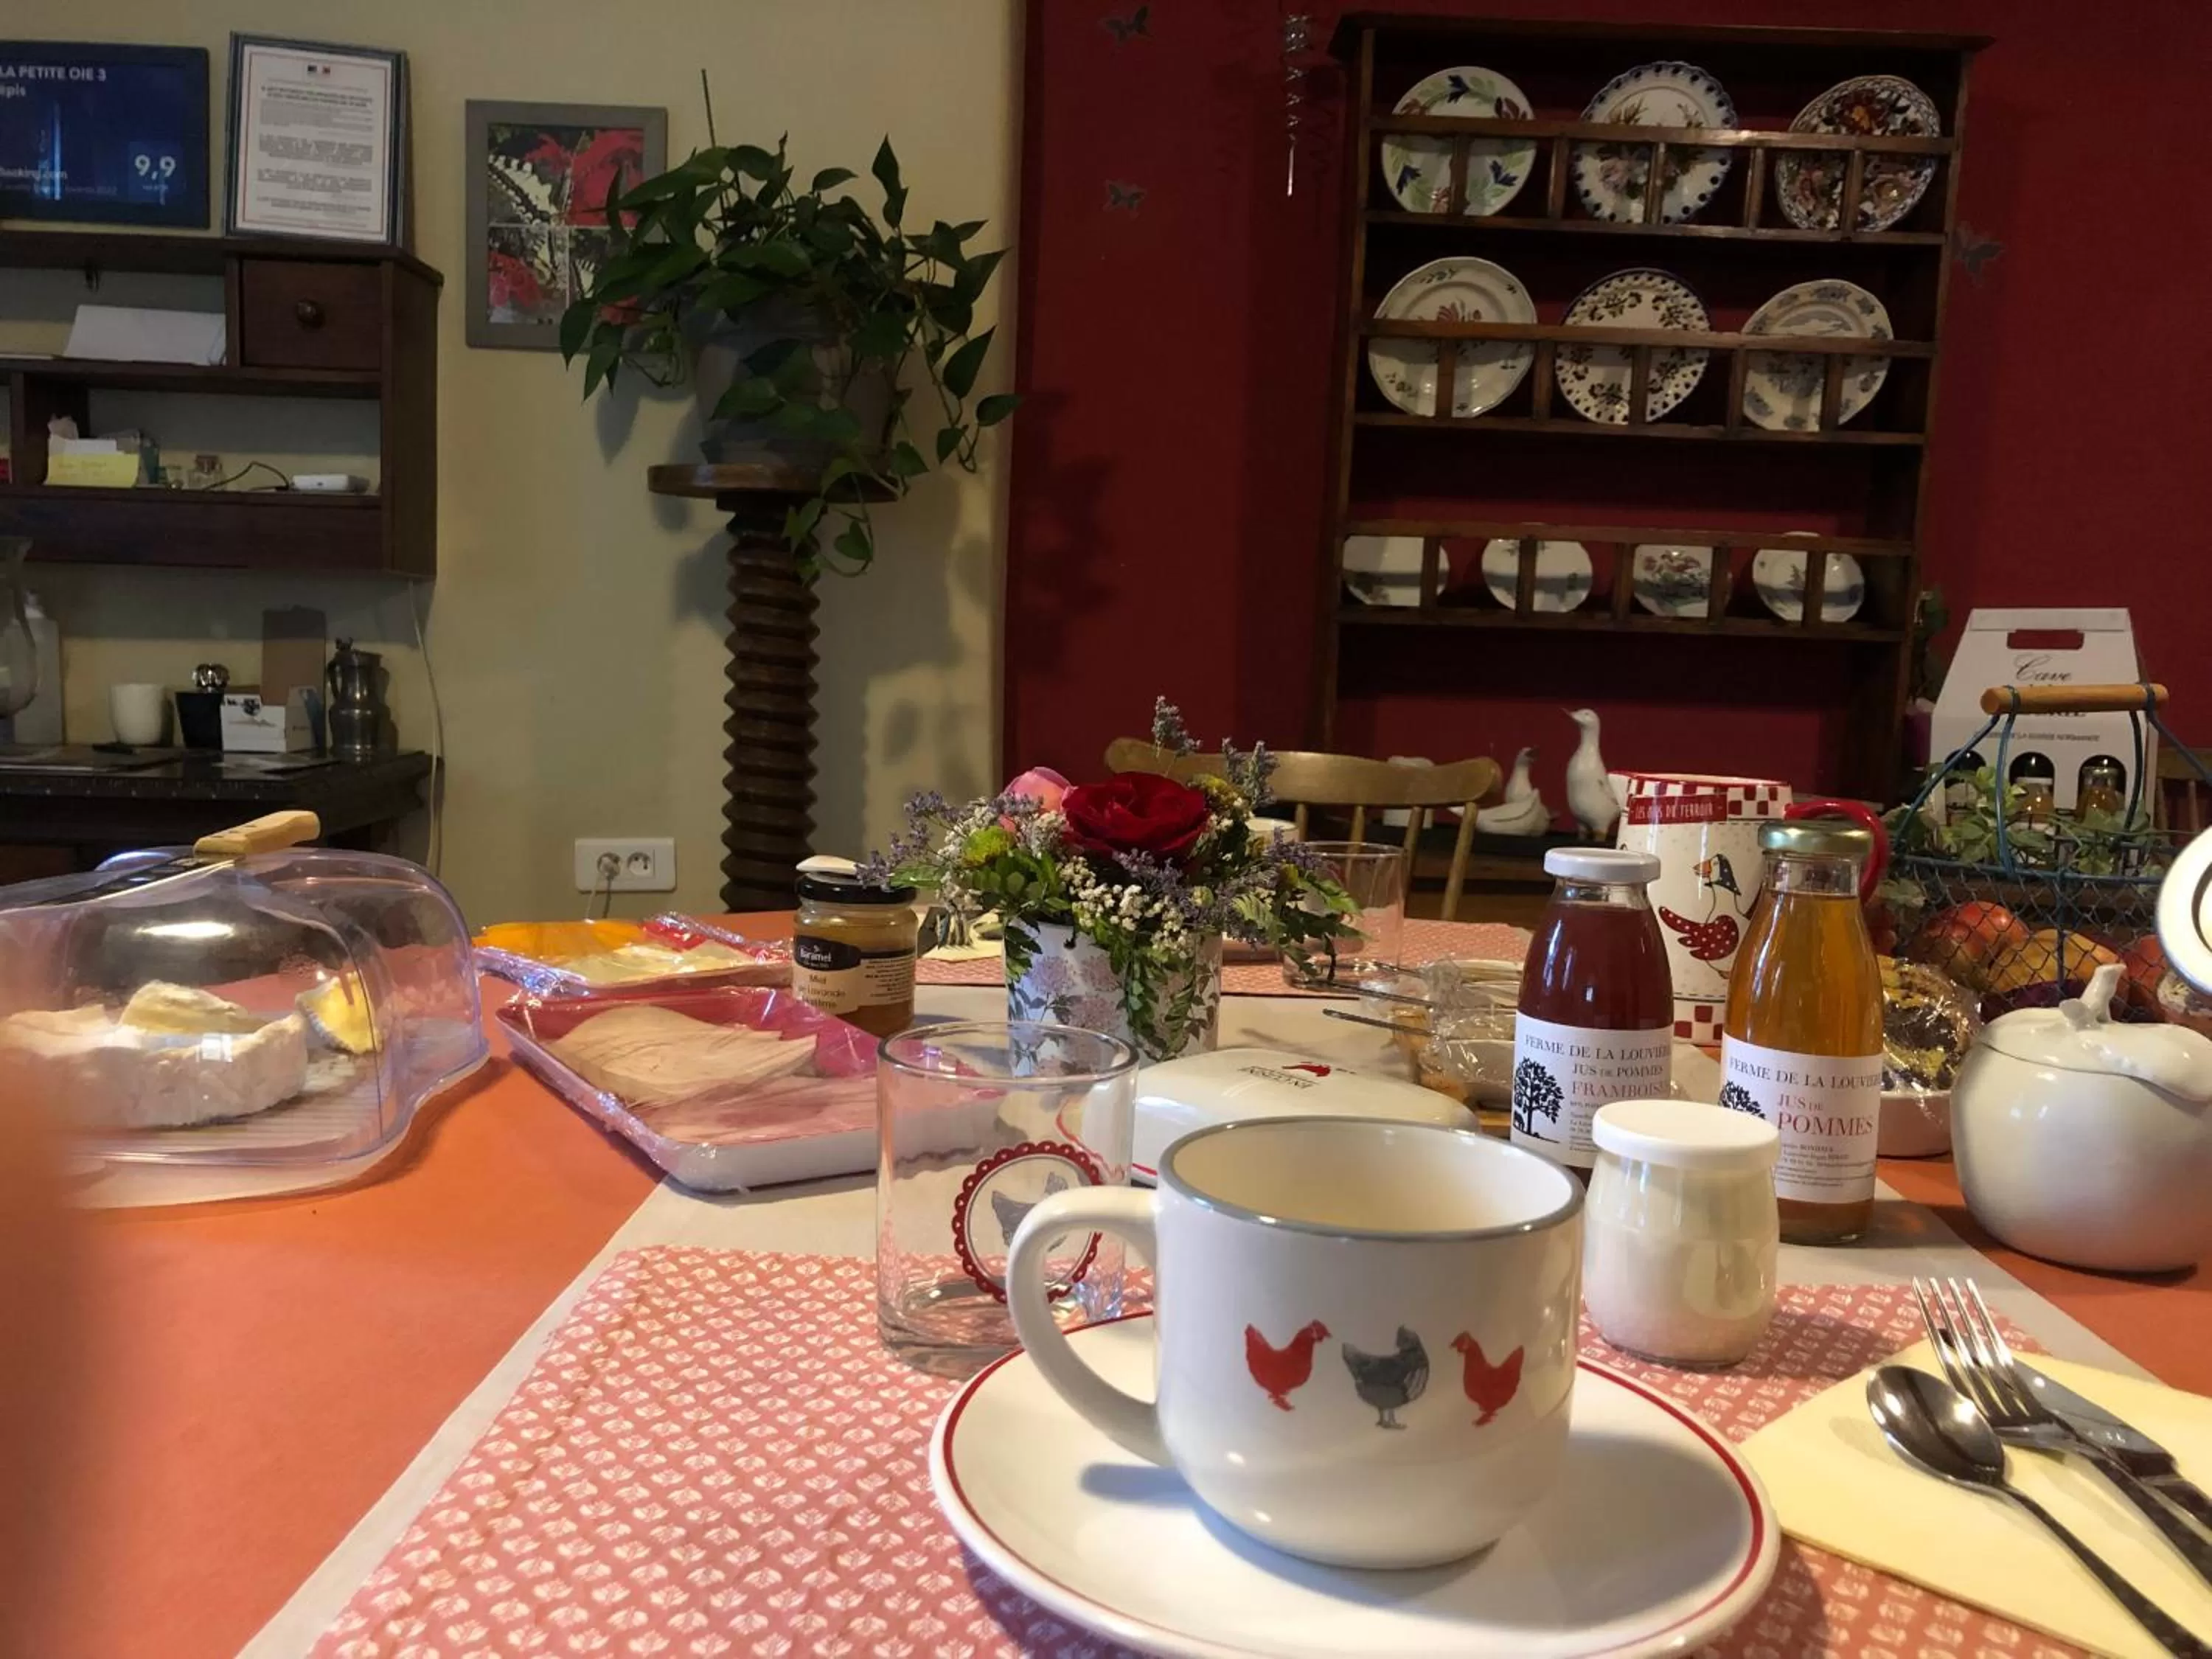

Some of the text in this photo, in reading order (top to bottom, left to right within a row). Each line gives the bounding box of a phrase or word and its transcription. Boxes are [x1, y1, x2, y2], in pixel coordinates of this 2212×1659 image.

[18, 65, 66, 80] PETITE
[69, 66, 94, 81] OIE
[97, 69, 106, 81] 3
[134, 154, 176, 180] 9,9
[2014, 652, 2072, 681] Cave
[1526, 1034, 1565, 1055] FERME
[1570, 1045, 1590, 1057] DE
[1596, 1048, 1615, 1060] LA
[1572, 1063, 1597, 1076] JUS
[1730, 1057, 1770, 1080] FERME
[1775, 1070, 1798, 1085] DE
[1804, 1074, 1823, 1088] LA
[1778, 1093, 1806, 1110] JUS
[1778, 1110, 1874, 1137] POMMES
